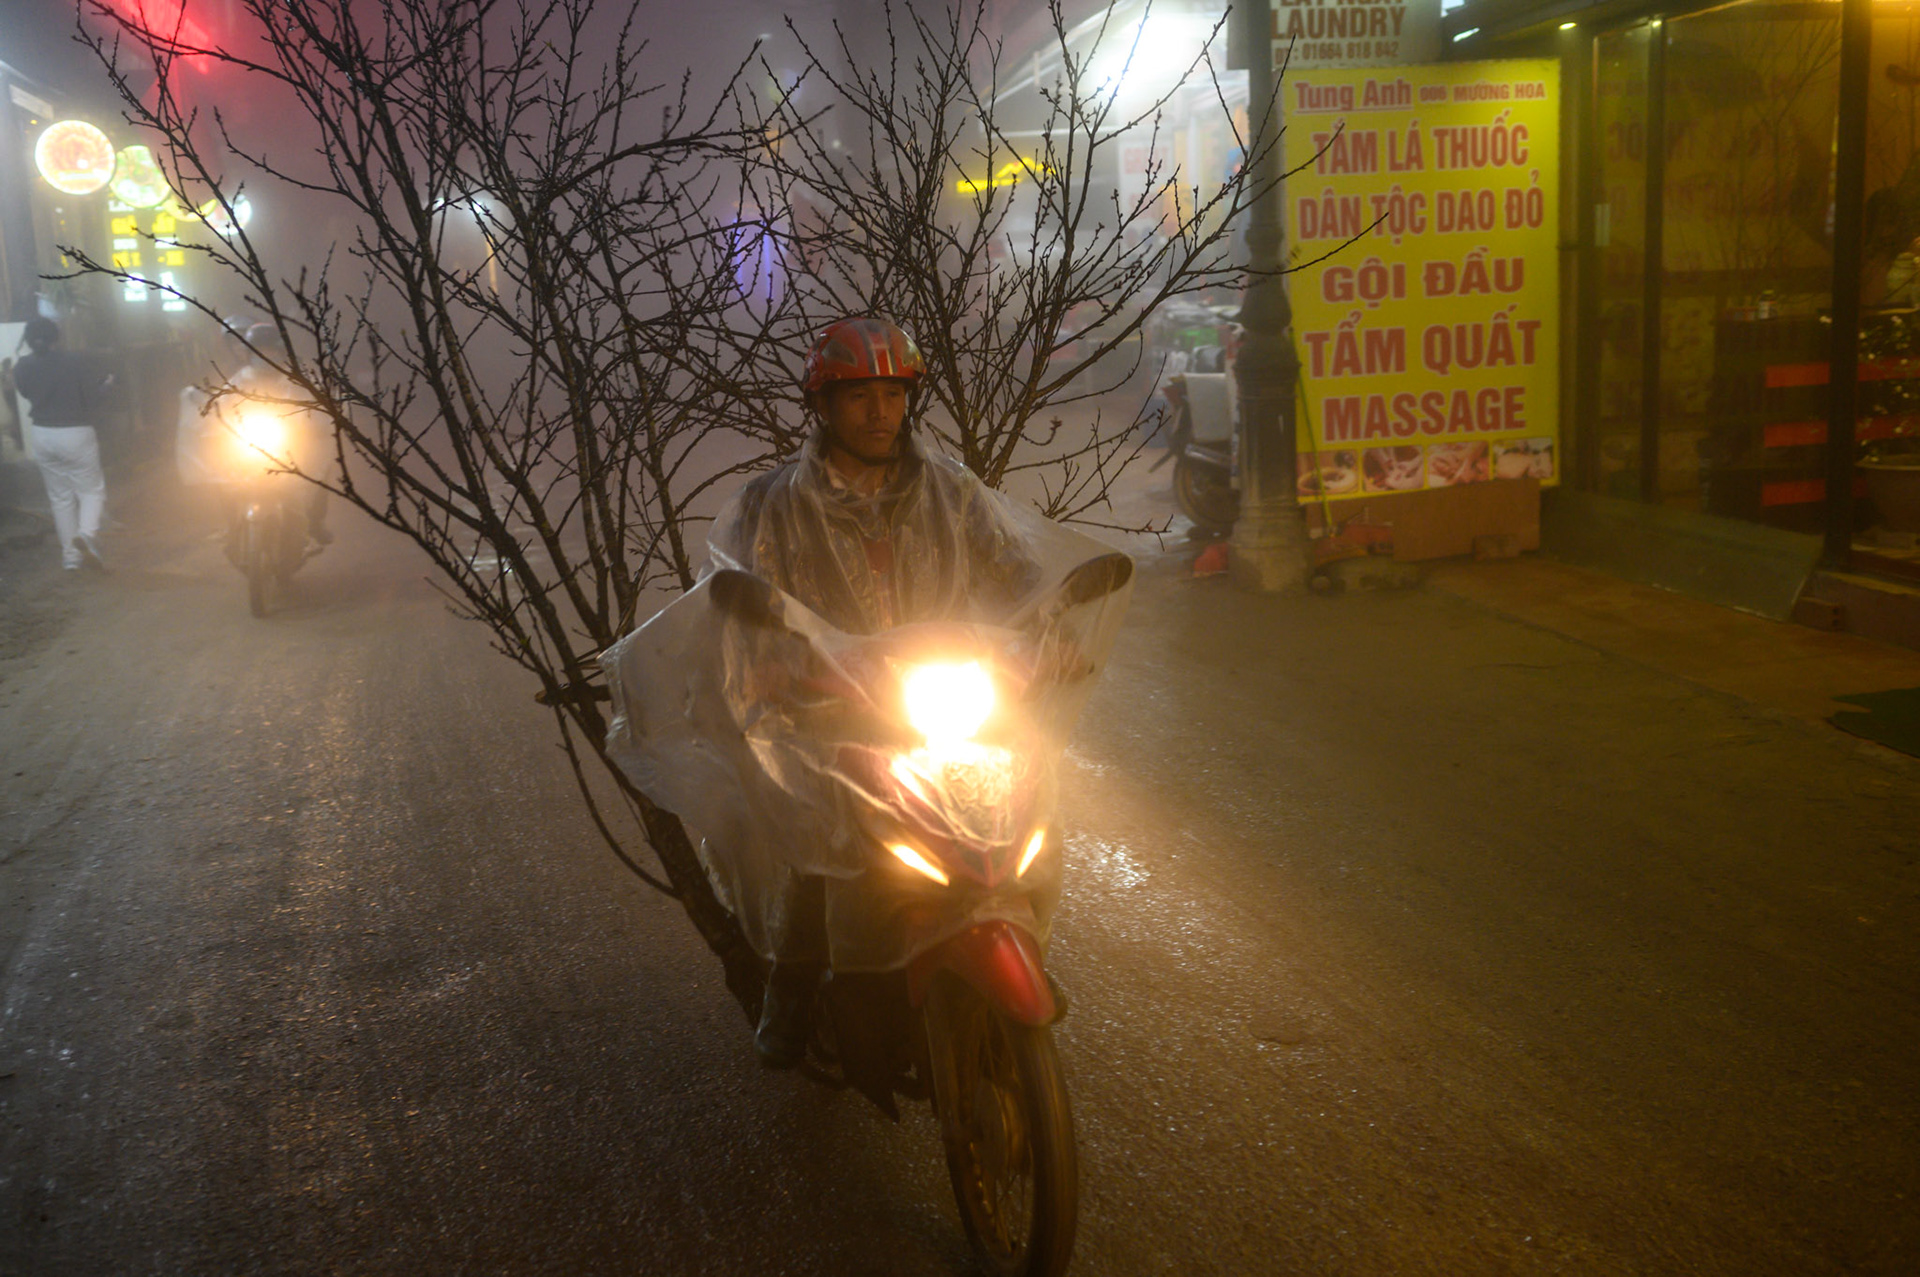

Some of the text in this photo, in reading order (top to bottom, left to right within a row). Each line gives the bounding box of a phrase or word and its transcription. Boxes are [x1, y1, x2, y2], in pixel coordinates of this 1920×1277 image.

[1270, 6, 1405, 39] LAUNDRY
[1294, 82, 1354, 111] Tung
[1363, 79, 1412, 106] Anh
[1514, 83, 1546, 99] HOA
[1388, 120, 1424, 172] LÁ
[1433, 109, 1529, 171] THUỐC
[1299, 168, 1544, 245] DÂN TỘC DAO ĐỎ
[1323, 246, 1525, 308] GỘI ĐẦU
[1303, 303, 1541, 378] TẨM QUẤT
[1323, 386, 1527, 442] MASSAGE
